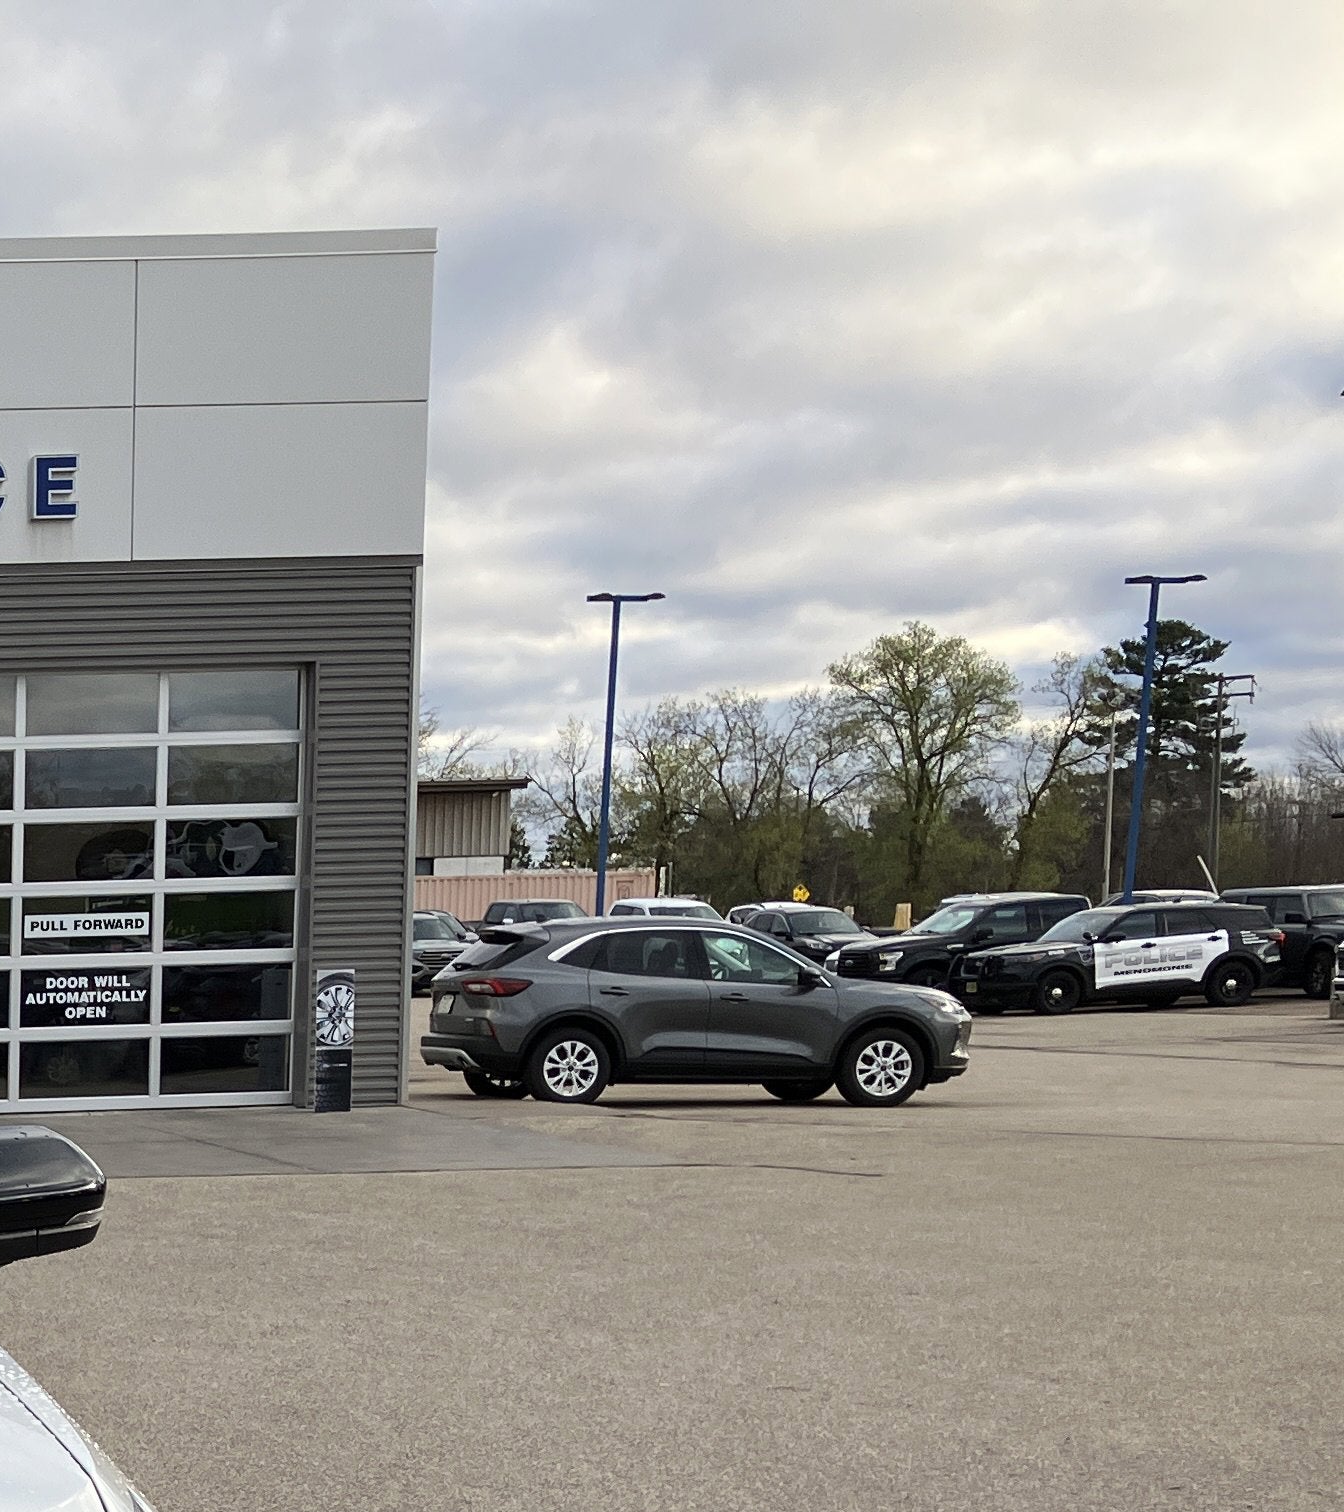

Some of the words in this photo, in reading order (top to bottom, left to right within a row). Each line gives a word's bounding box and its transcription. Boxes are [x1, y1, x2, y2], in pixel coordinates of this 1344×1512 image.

[30, 920, 67, 932] PULL
[73, 918, 145, 931] FORWARD
[1104, 944, 1203, 969] POLICE
[45, 976, 89, 989] DOOR
[93, 975, 131, 988] WILL
[25, 989, 147, 1005] AUTOMATICALLY
[64, 1005, 107, 1019] OPEN
